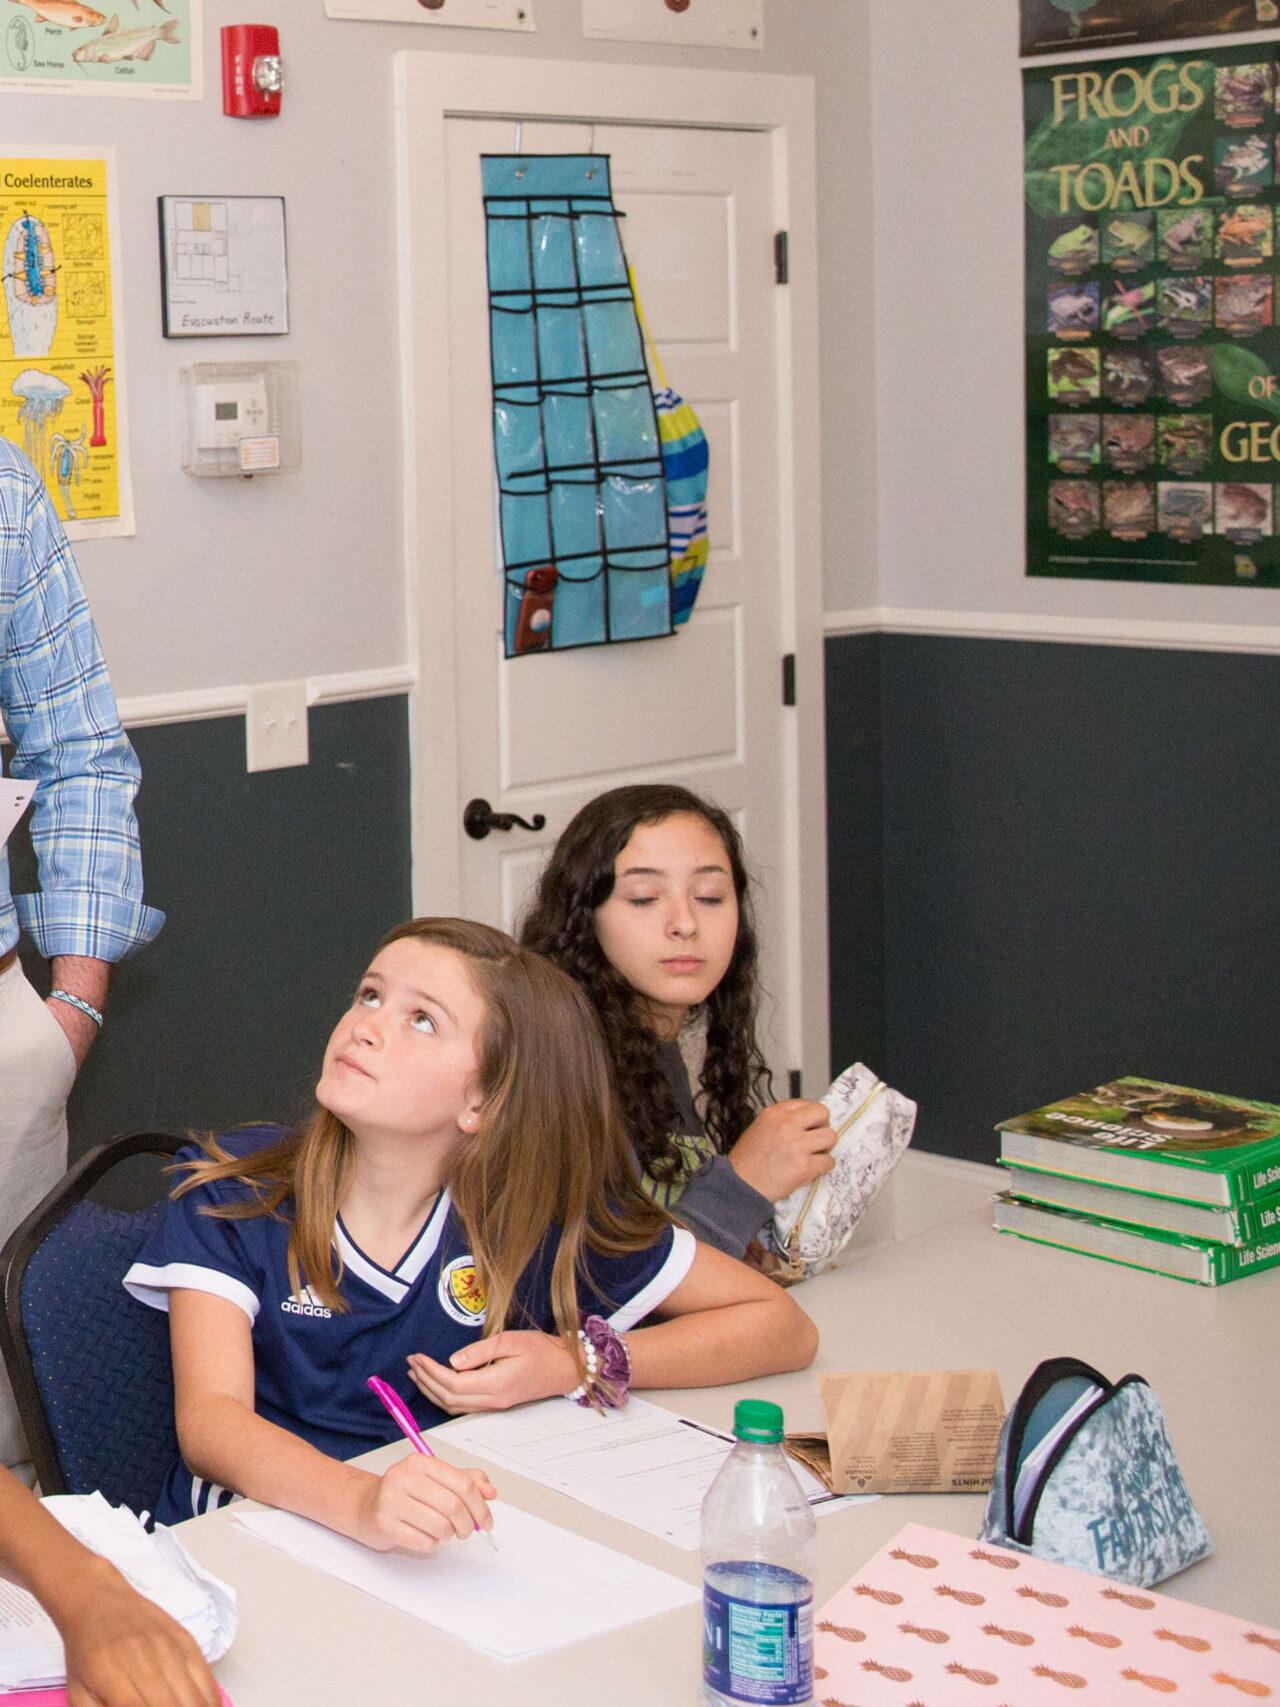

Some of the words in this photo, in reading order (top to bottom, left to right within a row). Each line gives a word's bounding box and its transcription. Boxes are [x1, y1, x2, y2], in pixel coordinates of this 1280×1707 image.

[1051, 60, 1205, 126] FROGS
[1104, 125, 1150, 149] AND
[5, 173, 93, 189] Coelenterates
[1049, 154, 1204, 213] TOADS
[182, 314, 238, 327] Evacuation
[243, 312, 274, 325] Route
[1248, 375, 1278, 399] OF
[1253, 1172, 1266, 1189] Life
[1267, 1165, 1280, 1183] Scie
[1260, 1210, 1276, 1228] Life
[1239, 1249, 1255, 1266] Life
[1256, 1242, 1280, 1260] Scien
[281, 1300, 332, 1318] adidas
